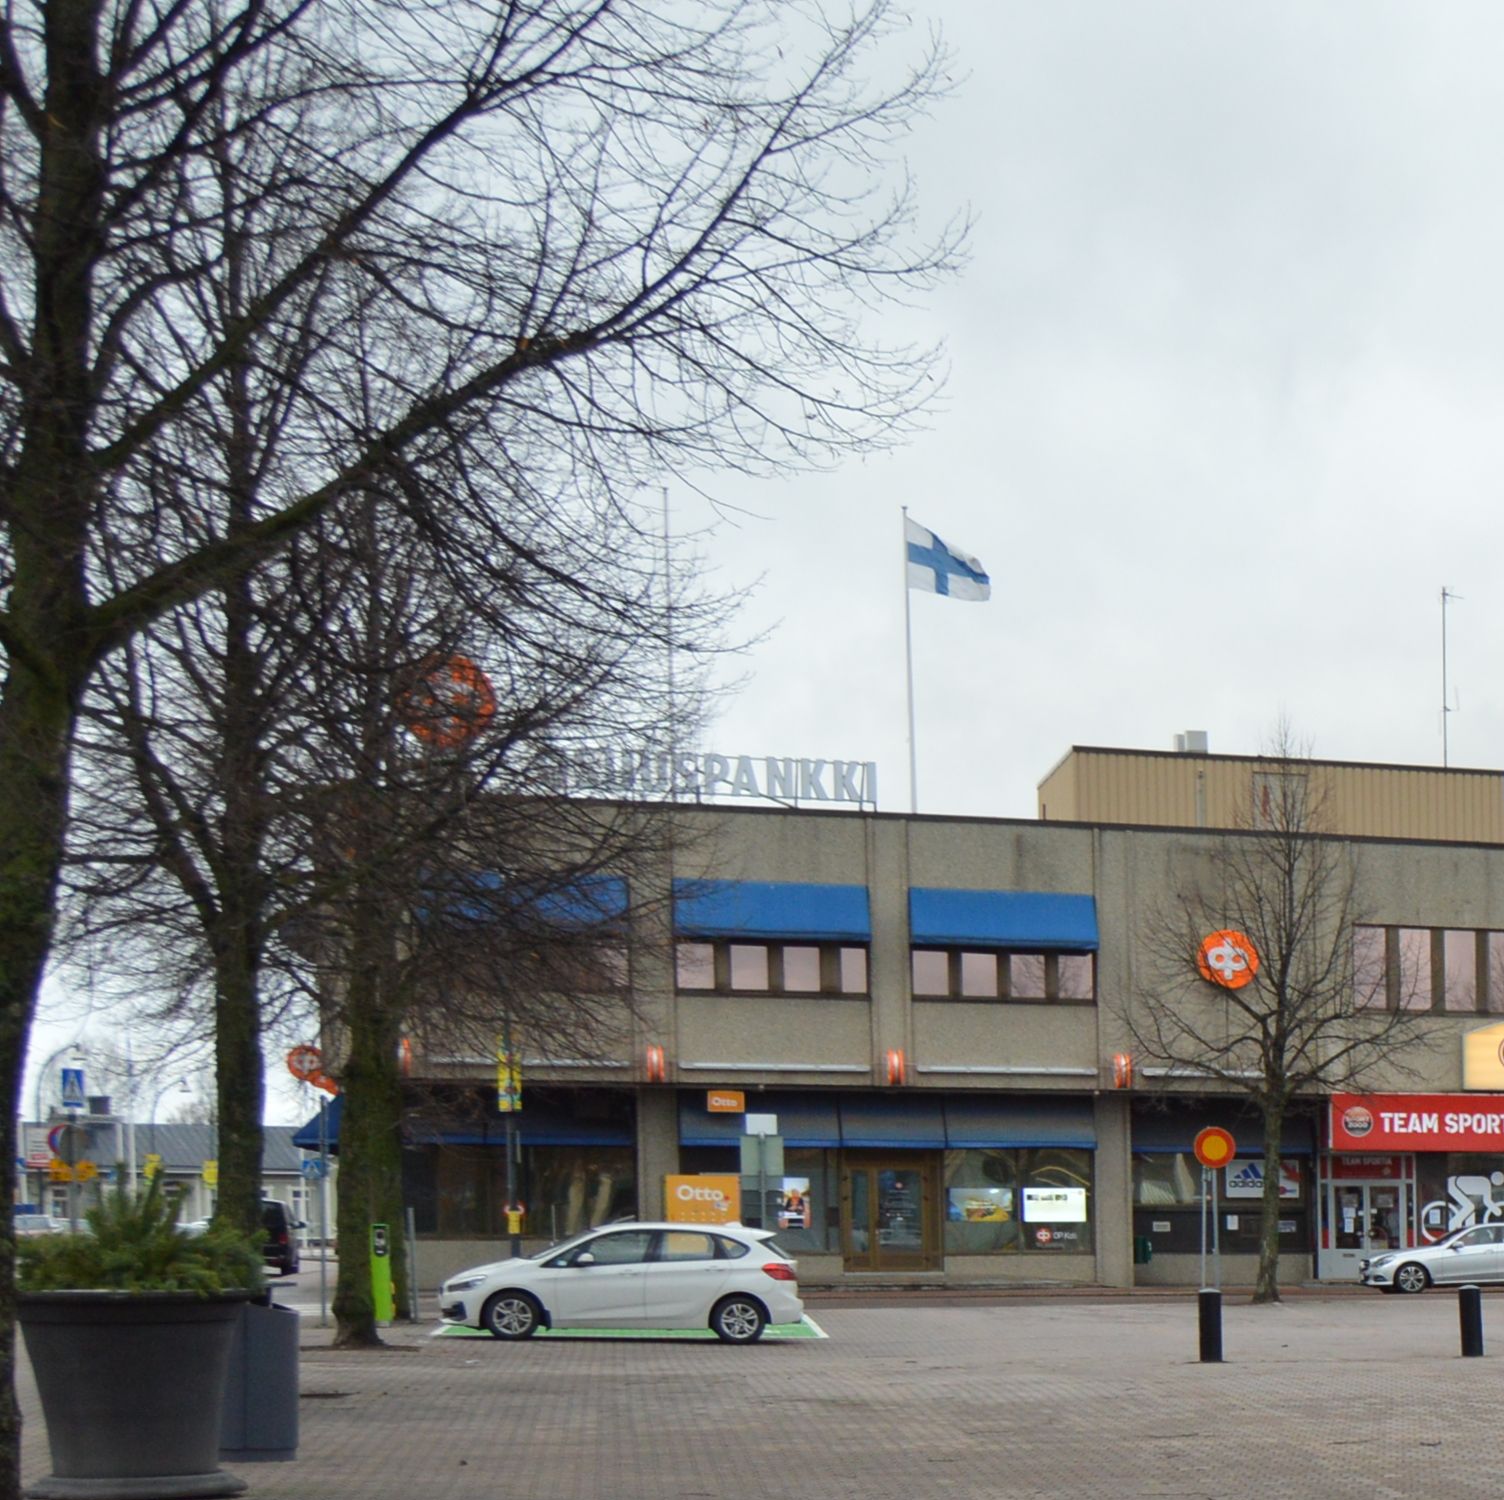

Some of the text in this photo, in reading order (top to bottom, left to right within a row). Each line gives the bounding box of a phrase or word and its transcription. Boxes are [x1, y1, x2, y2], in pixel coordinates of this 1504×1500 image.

[1380, 1112, 1439, 1133] TEAM
[1341, 1156, 1361, 1165] TEAM
[1228, 1178, 1264, 1188] adida
